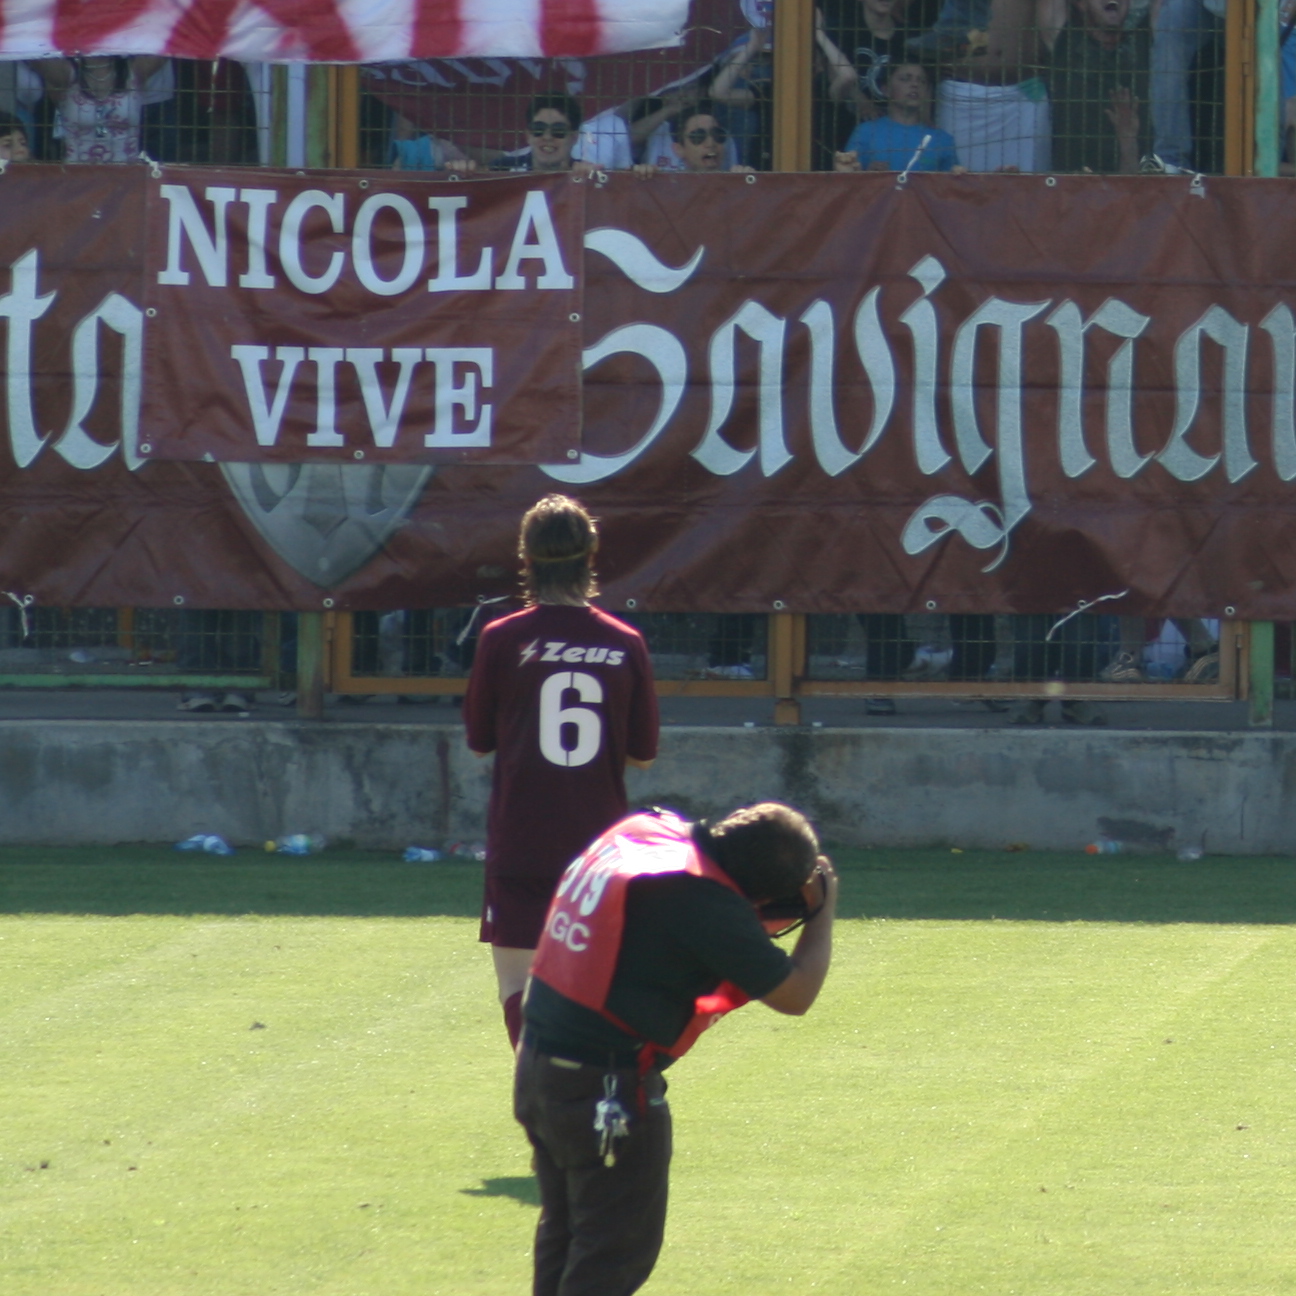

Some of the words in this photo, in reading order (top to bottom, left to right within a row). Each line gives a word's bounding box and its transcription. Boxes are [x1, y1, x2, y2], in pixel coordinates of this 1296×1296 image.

[156, 184, 575, 298] NICOLA
[230, 344, 495, 449] VIVE
[540, 641, 626, 667] Zeus
[538, 670, 603, 768] 6
